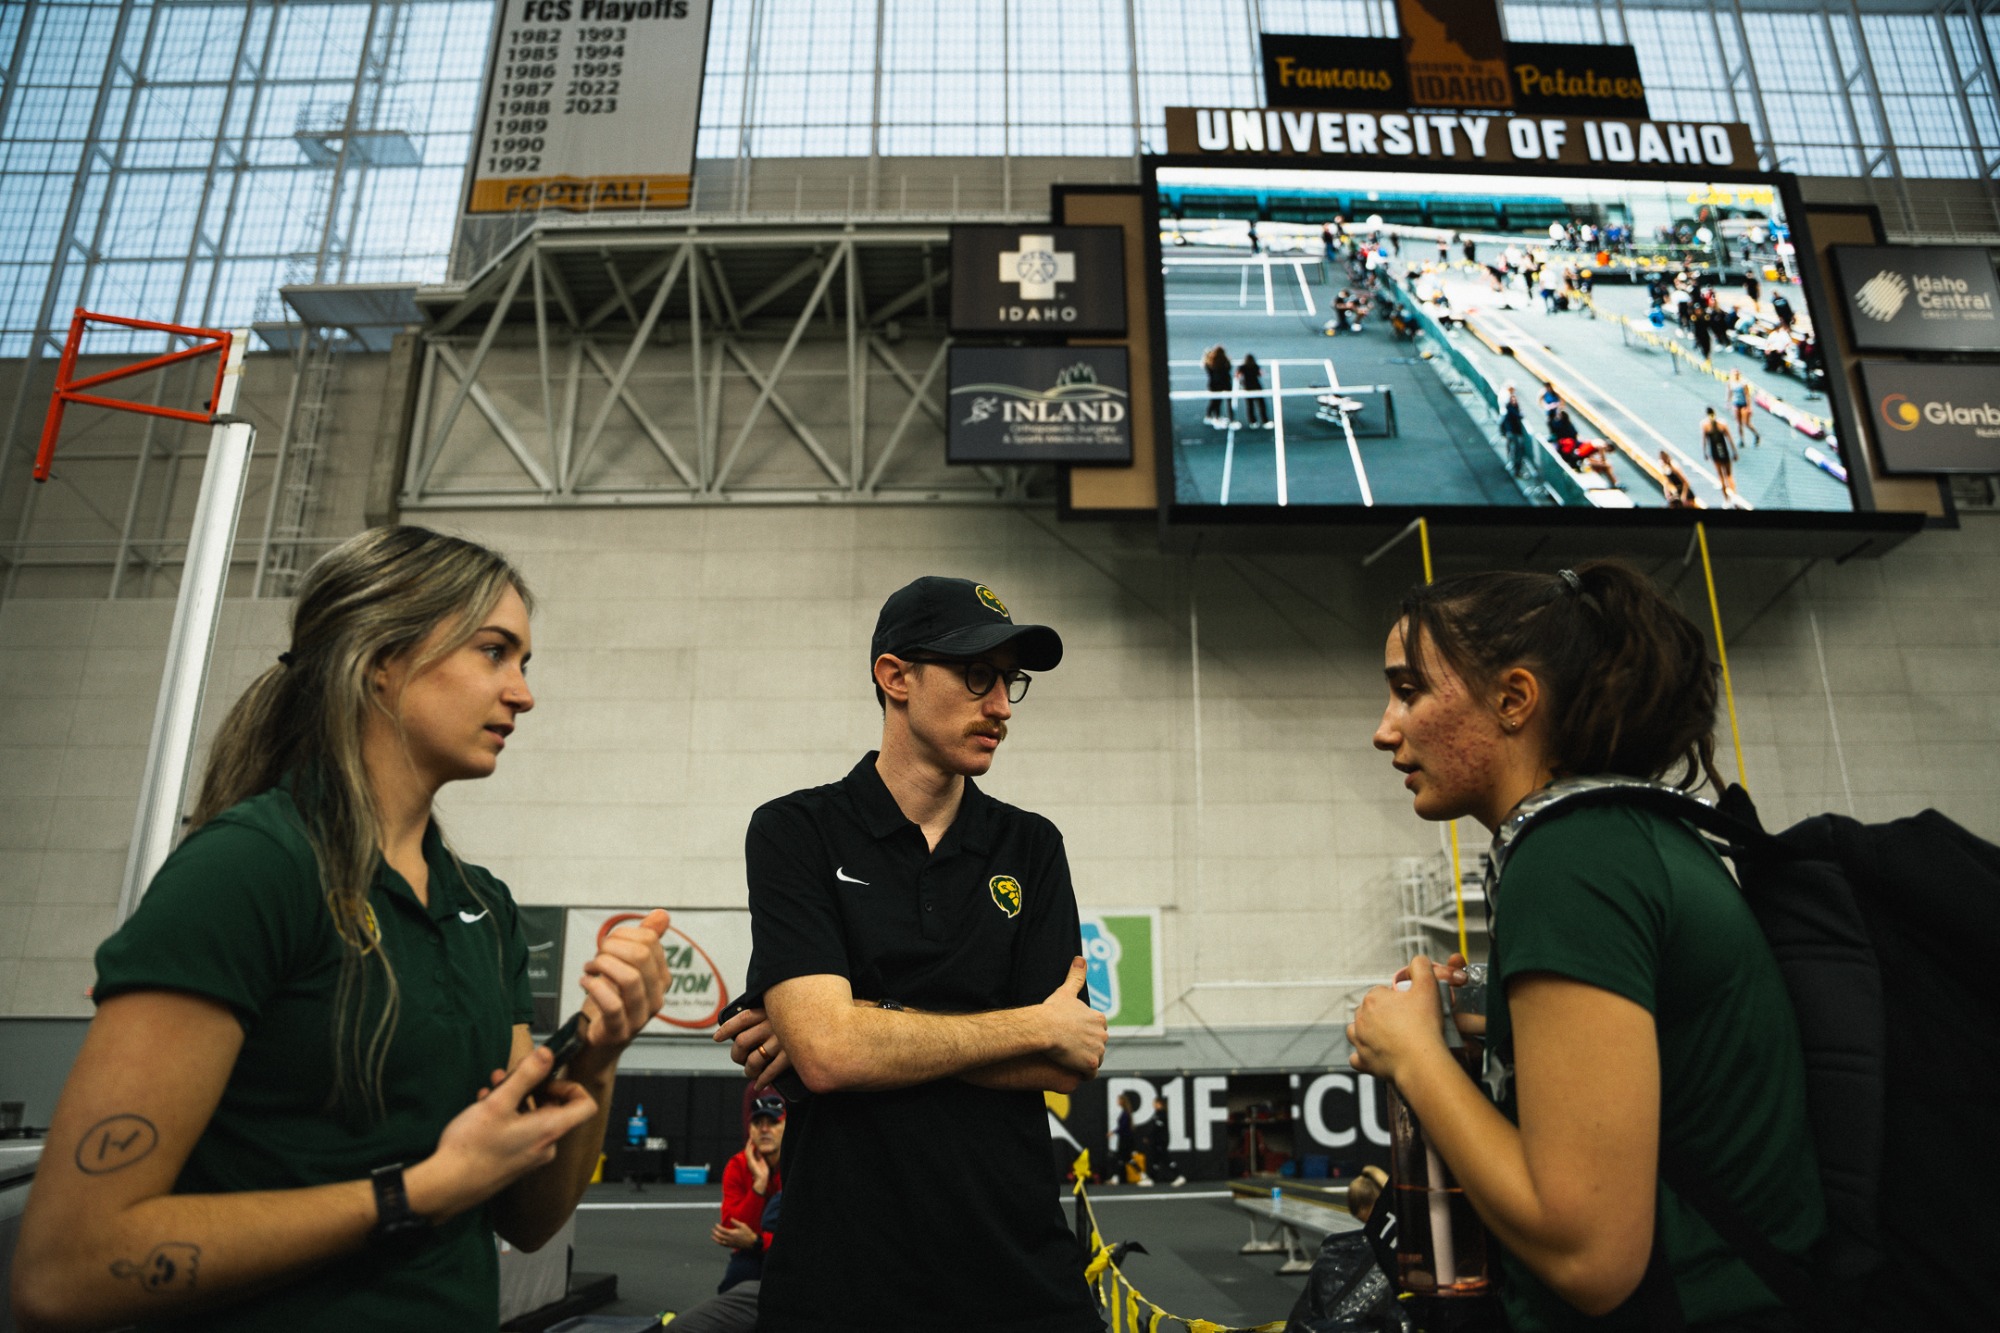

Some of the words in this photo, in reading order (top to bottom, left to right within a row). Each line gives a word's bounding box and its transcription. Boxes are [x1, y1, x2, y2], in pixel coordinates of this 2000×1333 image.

[522, 0, 572, 22] FCS
[580, 0, 689, 22] Playoffs
[510, 28, 562, 45] 1982
[578, 27, 627, 43] 1993
[508, 46, 559, 62] 1985
[575, 45, 625, 60] 1994
[504, 63, 557, 80] 1986
[573, 62, 622, 78] 1995
[1275, 56, 1392, 91] Famous
[501, 81, 553, 98] 1987
[566, 80, 620, 96] 2022
[1415, 75, 1507, 103] IDAHO
[1514, 64, 1645, 99] Potatoes
[497, 100, 550, 117] 1988
[563, 98, 617, 115] 2023
[494, 118, 548, 135] 1989
[491, 136, 545, 154] 1990
[1196, 109, 1490, 157] UNIVERSITY
[1507, 118, 1567, 160] OF
[1583, 120, 1735, 166] IDAHO
[487, 156, 541, 173] 1992
[1912, 274, 1969, 293] Idaho
[1917, 291, 1992, 310] Central
[999, 306, 1077, 322] IDAHO
[1002, 400, 1126, 423] INLAND
[1923, 401, 2000, 426] Glanb
